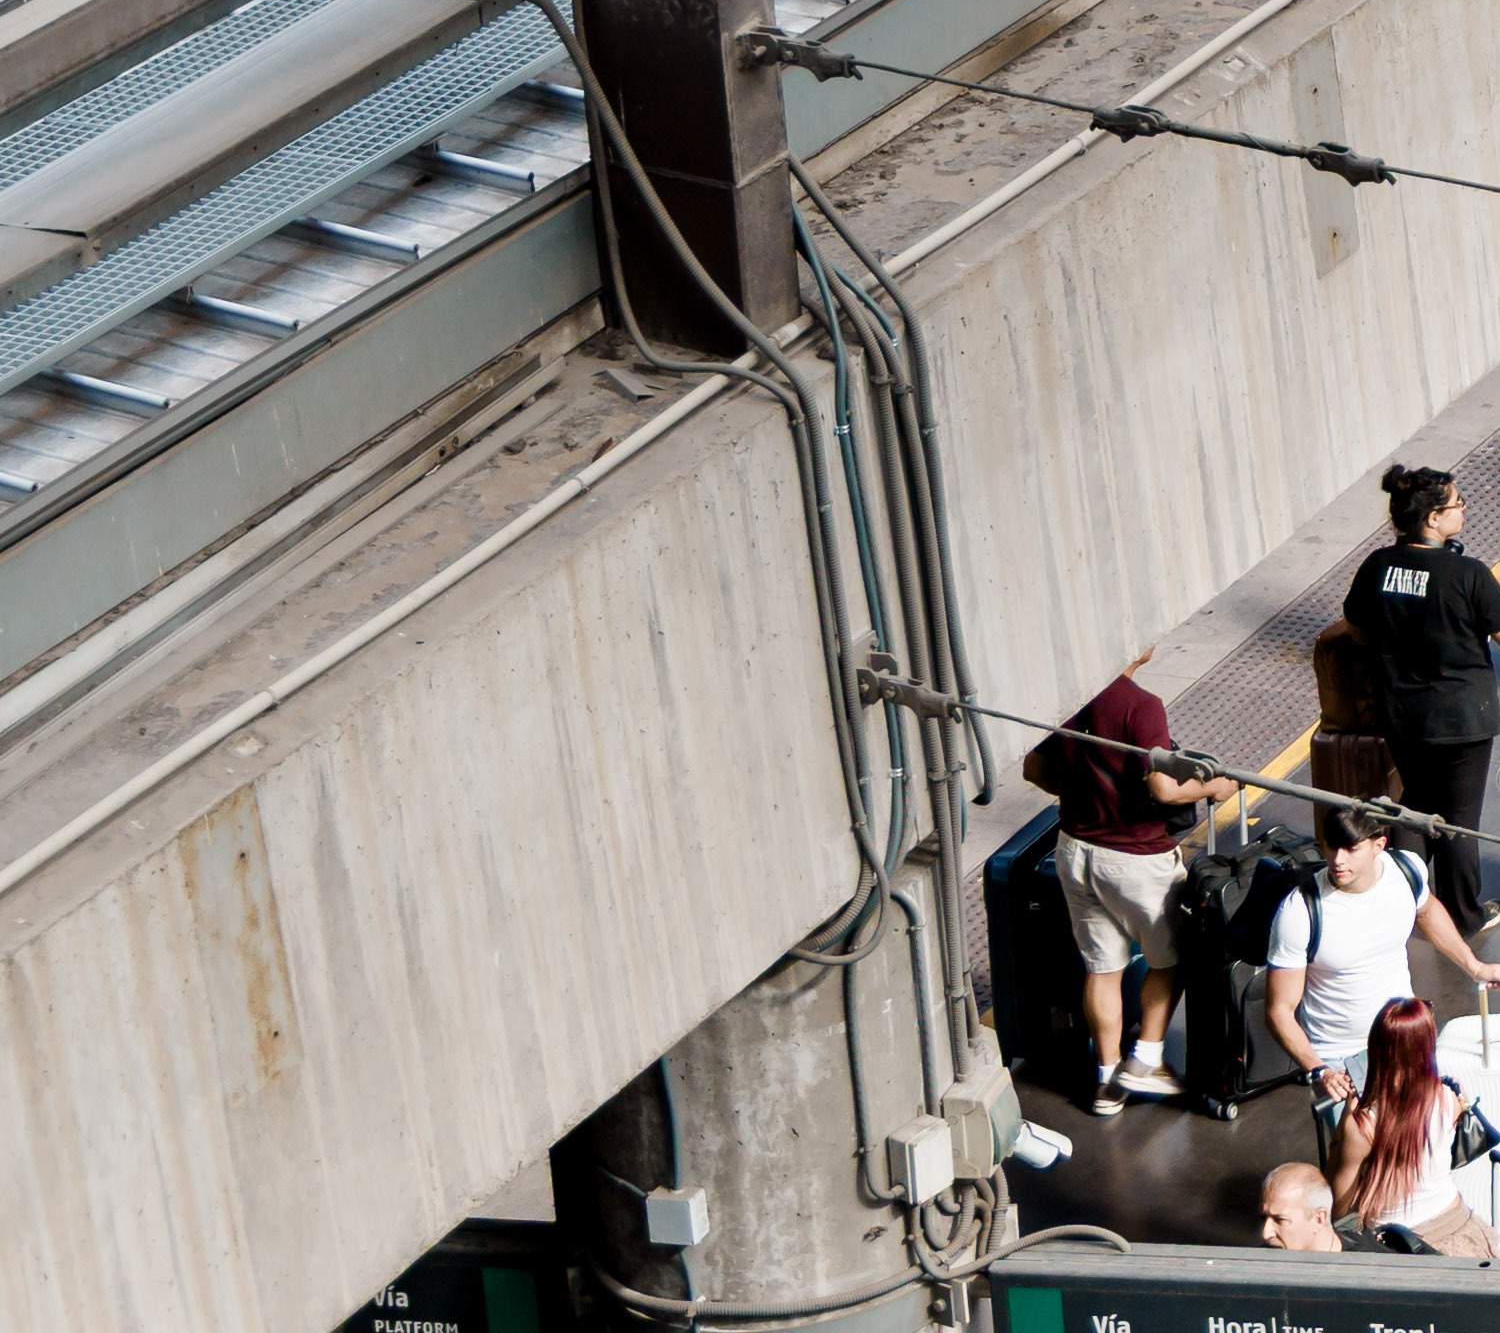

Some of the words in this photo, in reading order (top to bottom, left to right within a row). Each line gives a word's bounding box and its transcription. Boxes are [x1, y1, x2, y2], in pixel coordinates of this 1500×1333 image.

[374, 1285, 409, 1308] Vía
[375, 1319, 459, 1333] PLATFORM
[1091, 1314, 1131, 1333] Vía
[1208, 1316, 1267, 1333] Hora
